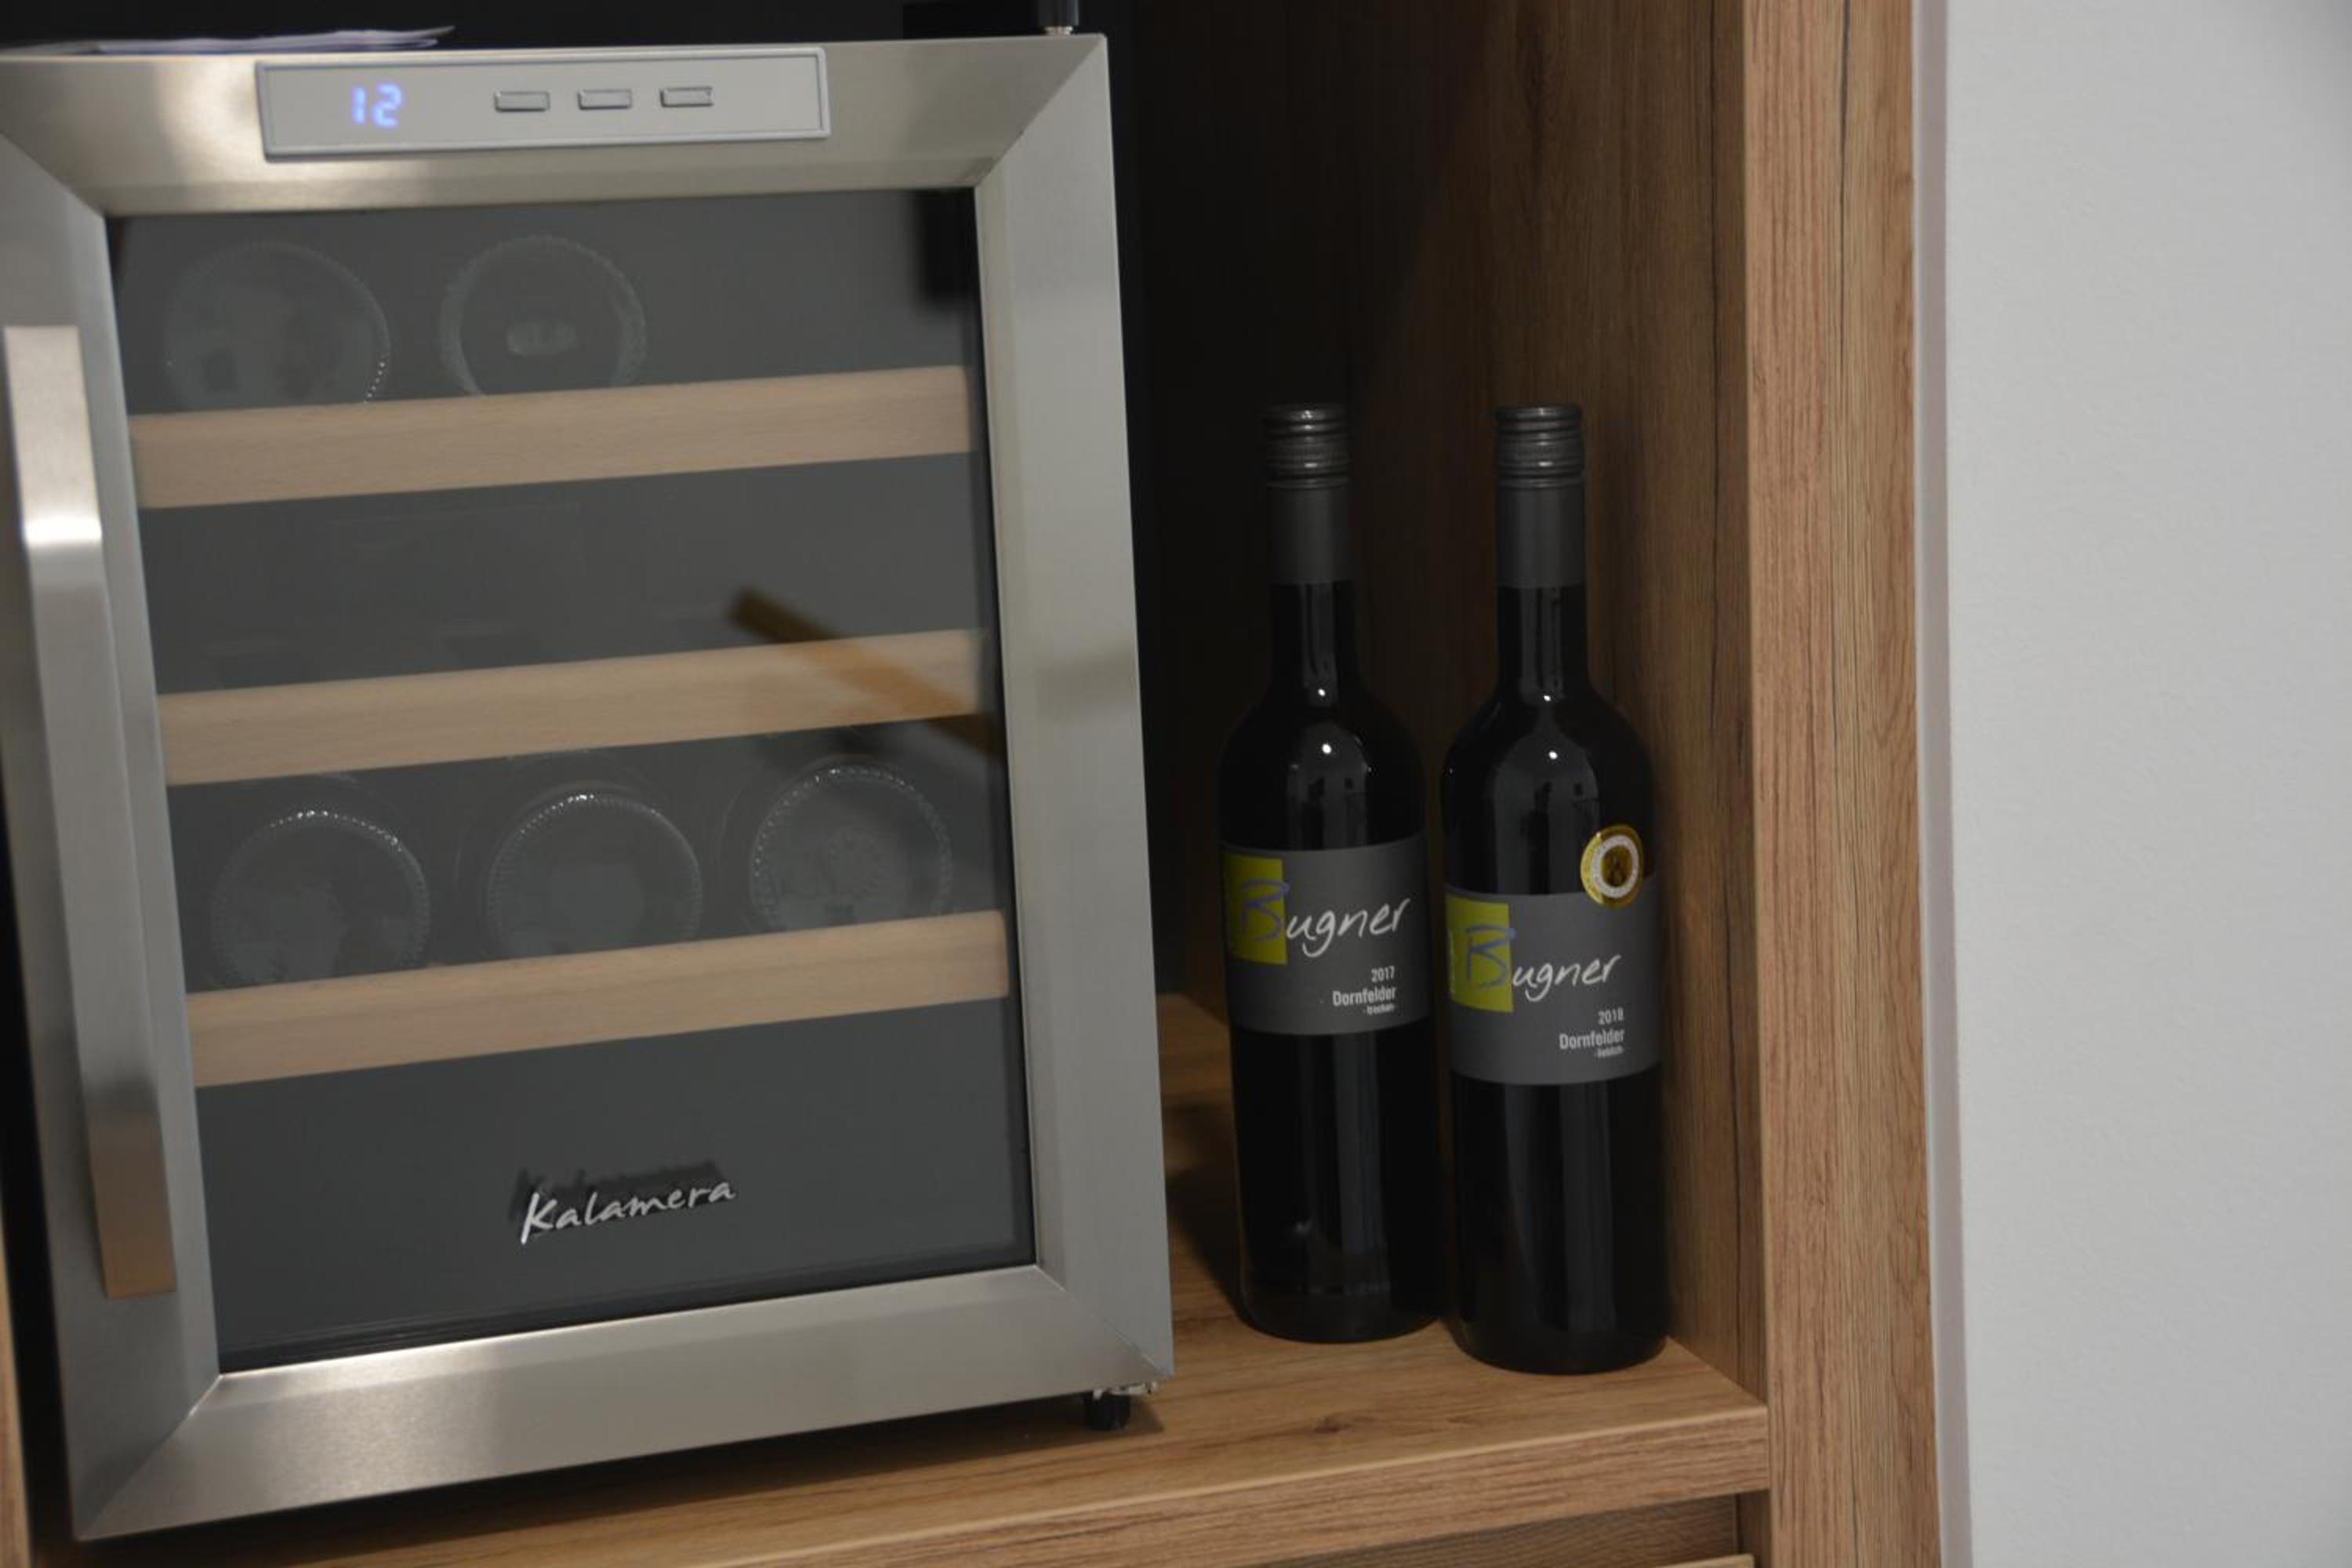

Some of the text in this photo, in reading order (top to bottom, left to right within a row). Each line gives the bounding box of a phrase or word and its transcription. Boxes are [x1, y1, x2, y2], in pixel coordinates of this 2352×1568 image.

[351, 83, 403, 128] 12
[1241, 879, 1411, 958] Bugner
[1370, 965, 1396, 983] 2017
[1466, 924, 1621, 1003] Bugner
[1332, 985, 1397, 1007] Dornfelder
[1597, 1007, 1624, 1025] 2018
[1559, 1028, 1625, 1051] Dornfelder
[520, 1178, 737, 1245] Kalamera
